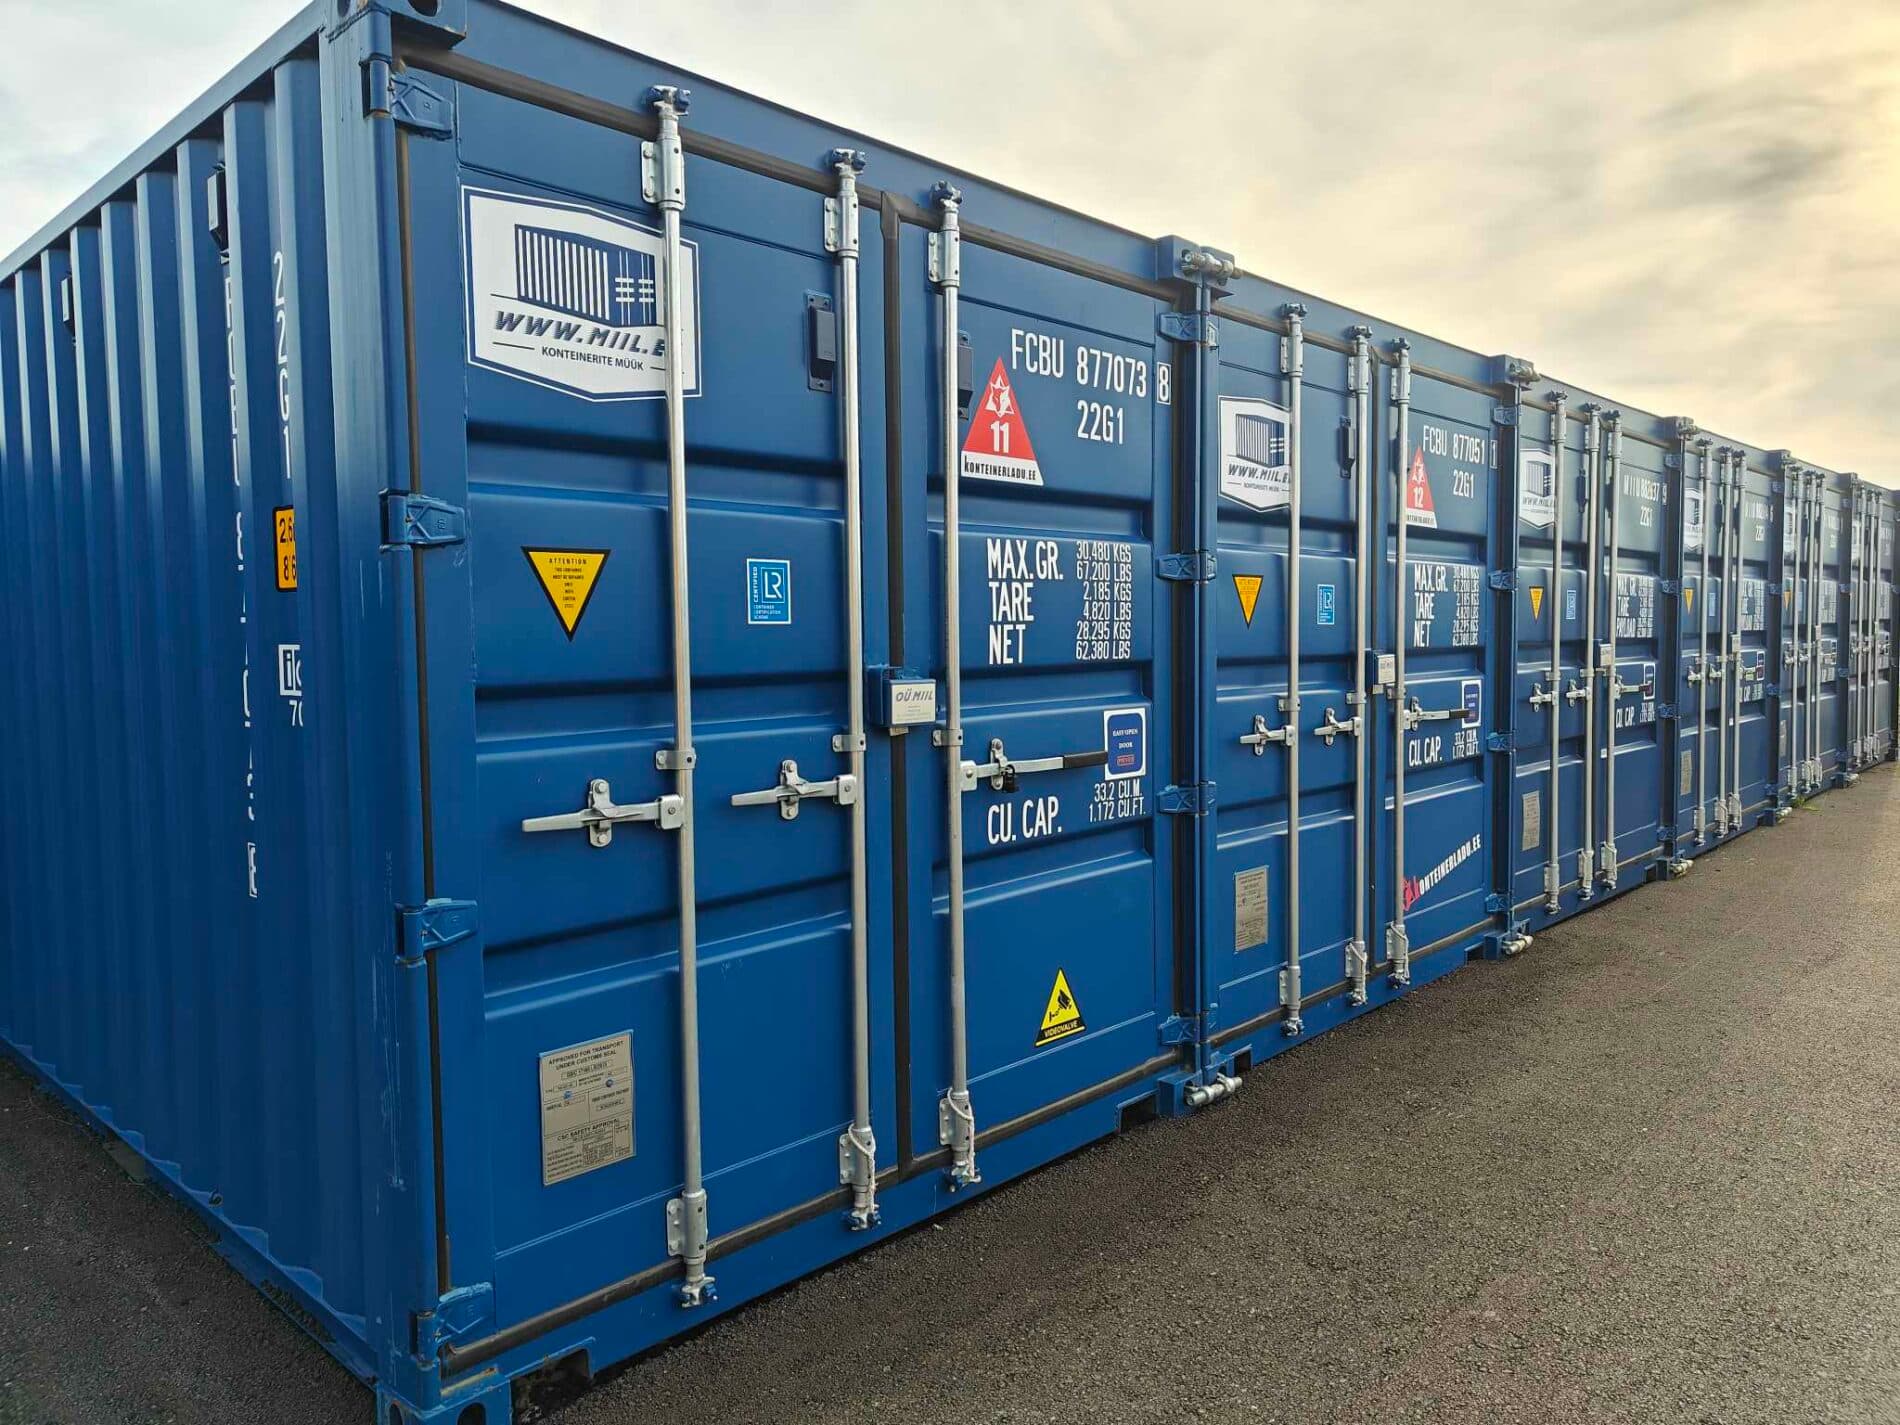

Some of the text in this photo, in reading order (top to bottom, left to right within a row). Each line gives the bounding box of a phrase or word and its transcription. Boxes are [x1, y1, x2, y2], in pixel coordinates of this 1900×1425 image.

[494, 310, 665, 356] WWW.MIIL.E
[273, 251, 292, 480] 22G1
[542, 346, 644, 371] KONTEINERITE MÜÜK
[1011, 328, 1170, 403] FCBU 877073 8
[1076, 400, 1124, 445] 22G1
[990, 420, 1010, 453] 11
[1423, 425, 1447, 456] FCBU
[1453, 433, 1485, 465] 877051
[1453, 469, 1474, 498] 22G1
[1413, 487, 1424, 508] 12
[279, 517, 296, 544] 2.6
[1113, 543, 1132, 563] KGS
[765, 571, 783, 598] LR
[1113, 562, 1132, 582] LBS
[989, 581, 1034, 622] TARE
[1113, 582, 1132, 602] KGS
[1113, 602, 1132, 621] LBS
[1415, 592, 1435, 620] TARE
[989, 624, 1026, 664] NET
[1113, 621, 1131, 640] KGS
[1414, 620, 1431, 648] NET
[1112, 640, 1131, 660] LBS
[896, 688, 933, 702] OÜ MIIL
[1424, 735, 1443, 765] CAP.
[1094, 782, 1115, 802] 33.2
[988, 796, 1062, 845] CU. CAP.
[549, 1040, 624, 1065] APPROVED FOR TRANSPORT
